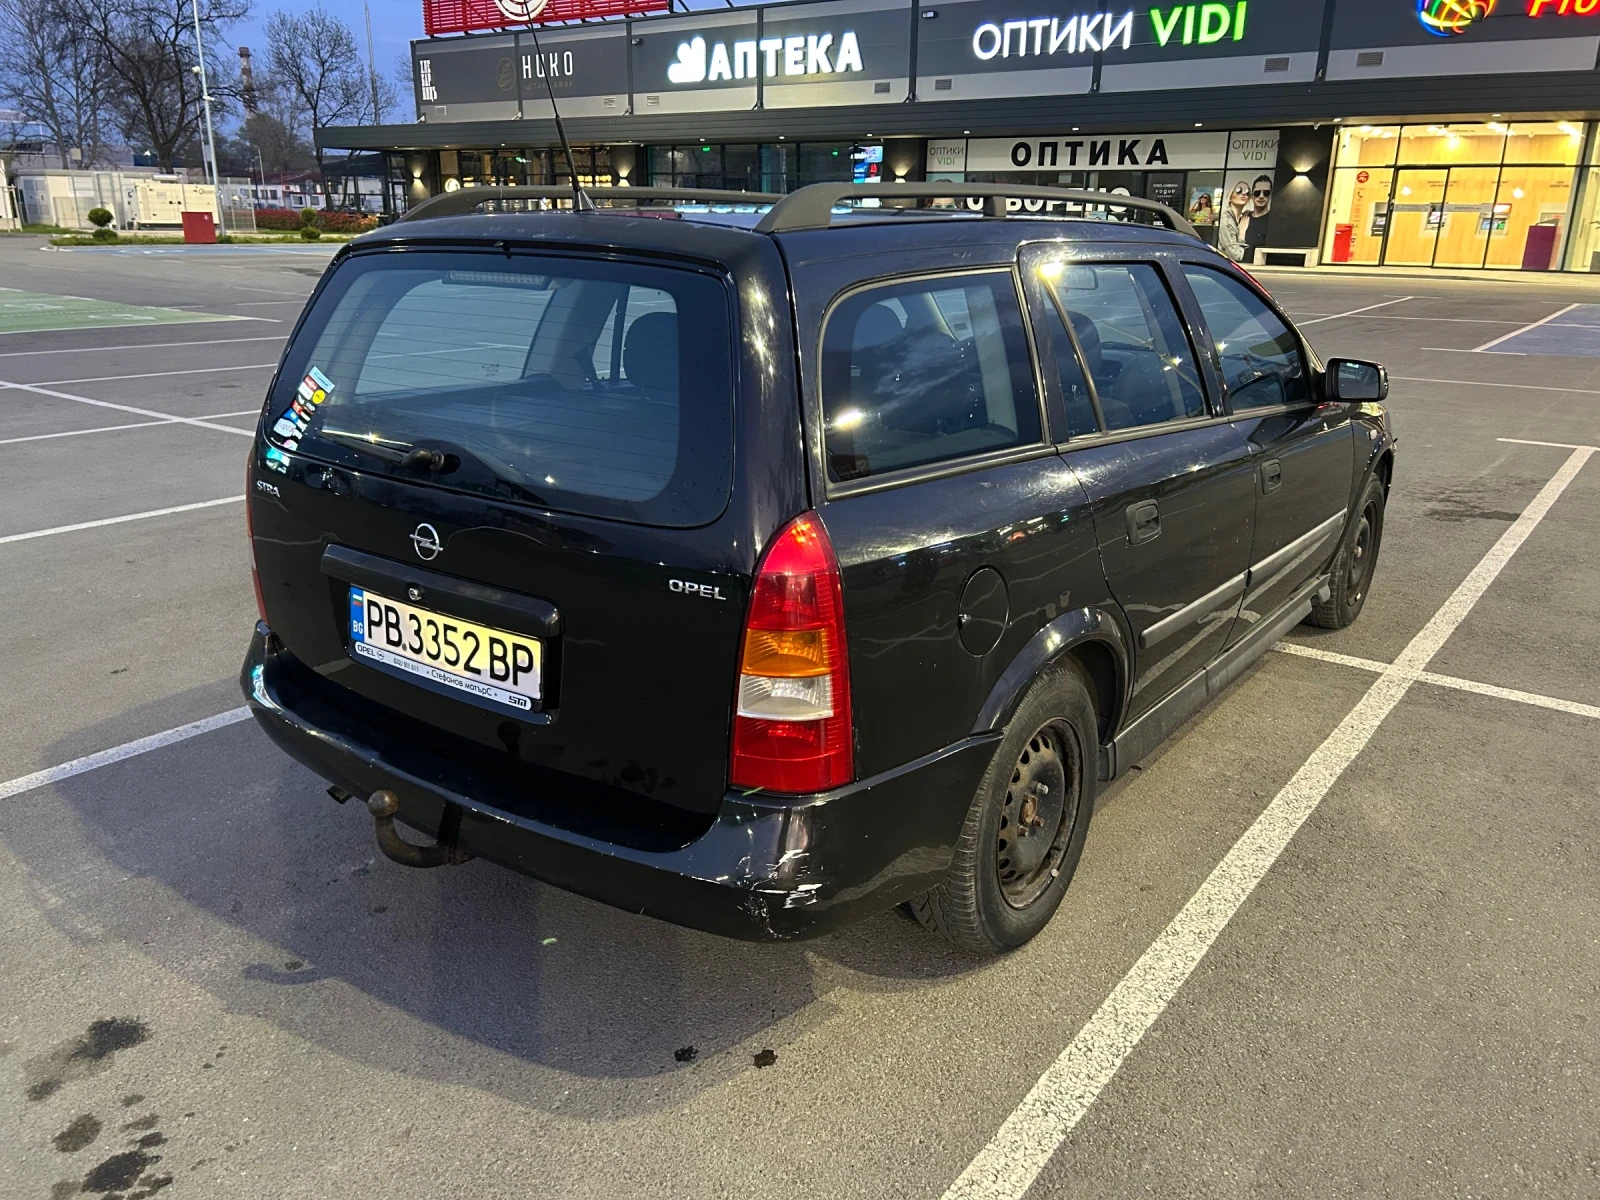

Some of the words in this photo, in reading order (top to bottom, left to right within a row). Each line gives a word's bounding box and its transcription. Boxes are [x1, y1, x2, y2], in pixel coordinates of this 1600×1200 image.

[973, 11, 1134, 60] ОПТИКИ
[1150, 1, 1247, 47] VIDI
[708, 31, 864, 81] АПТЕКА
[929, 146, 964, 156] ОПТИКИ
[1011, 138, 1169, 167] ОПТИКА
[1232, 138, 1280, 150] ОПТИКИ
[937, 157, 956, 166] VIDI
[1243, 151, 1267, 162] VIDI
[668, 579, 727, 601] OPEL
[352, 619, 364, 635] BG
[357, 644, 376, 657] OPEL
[431, 669, 464, 687] Стефанов
